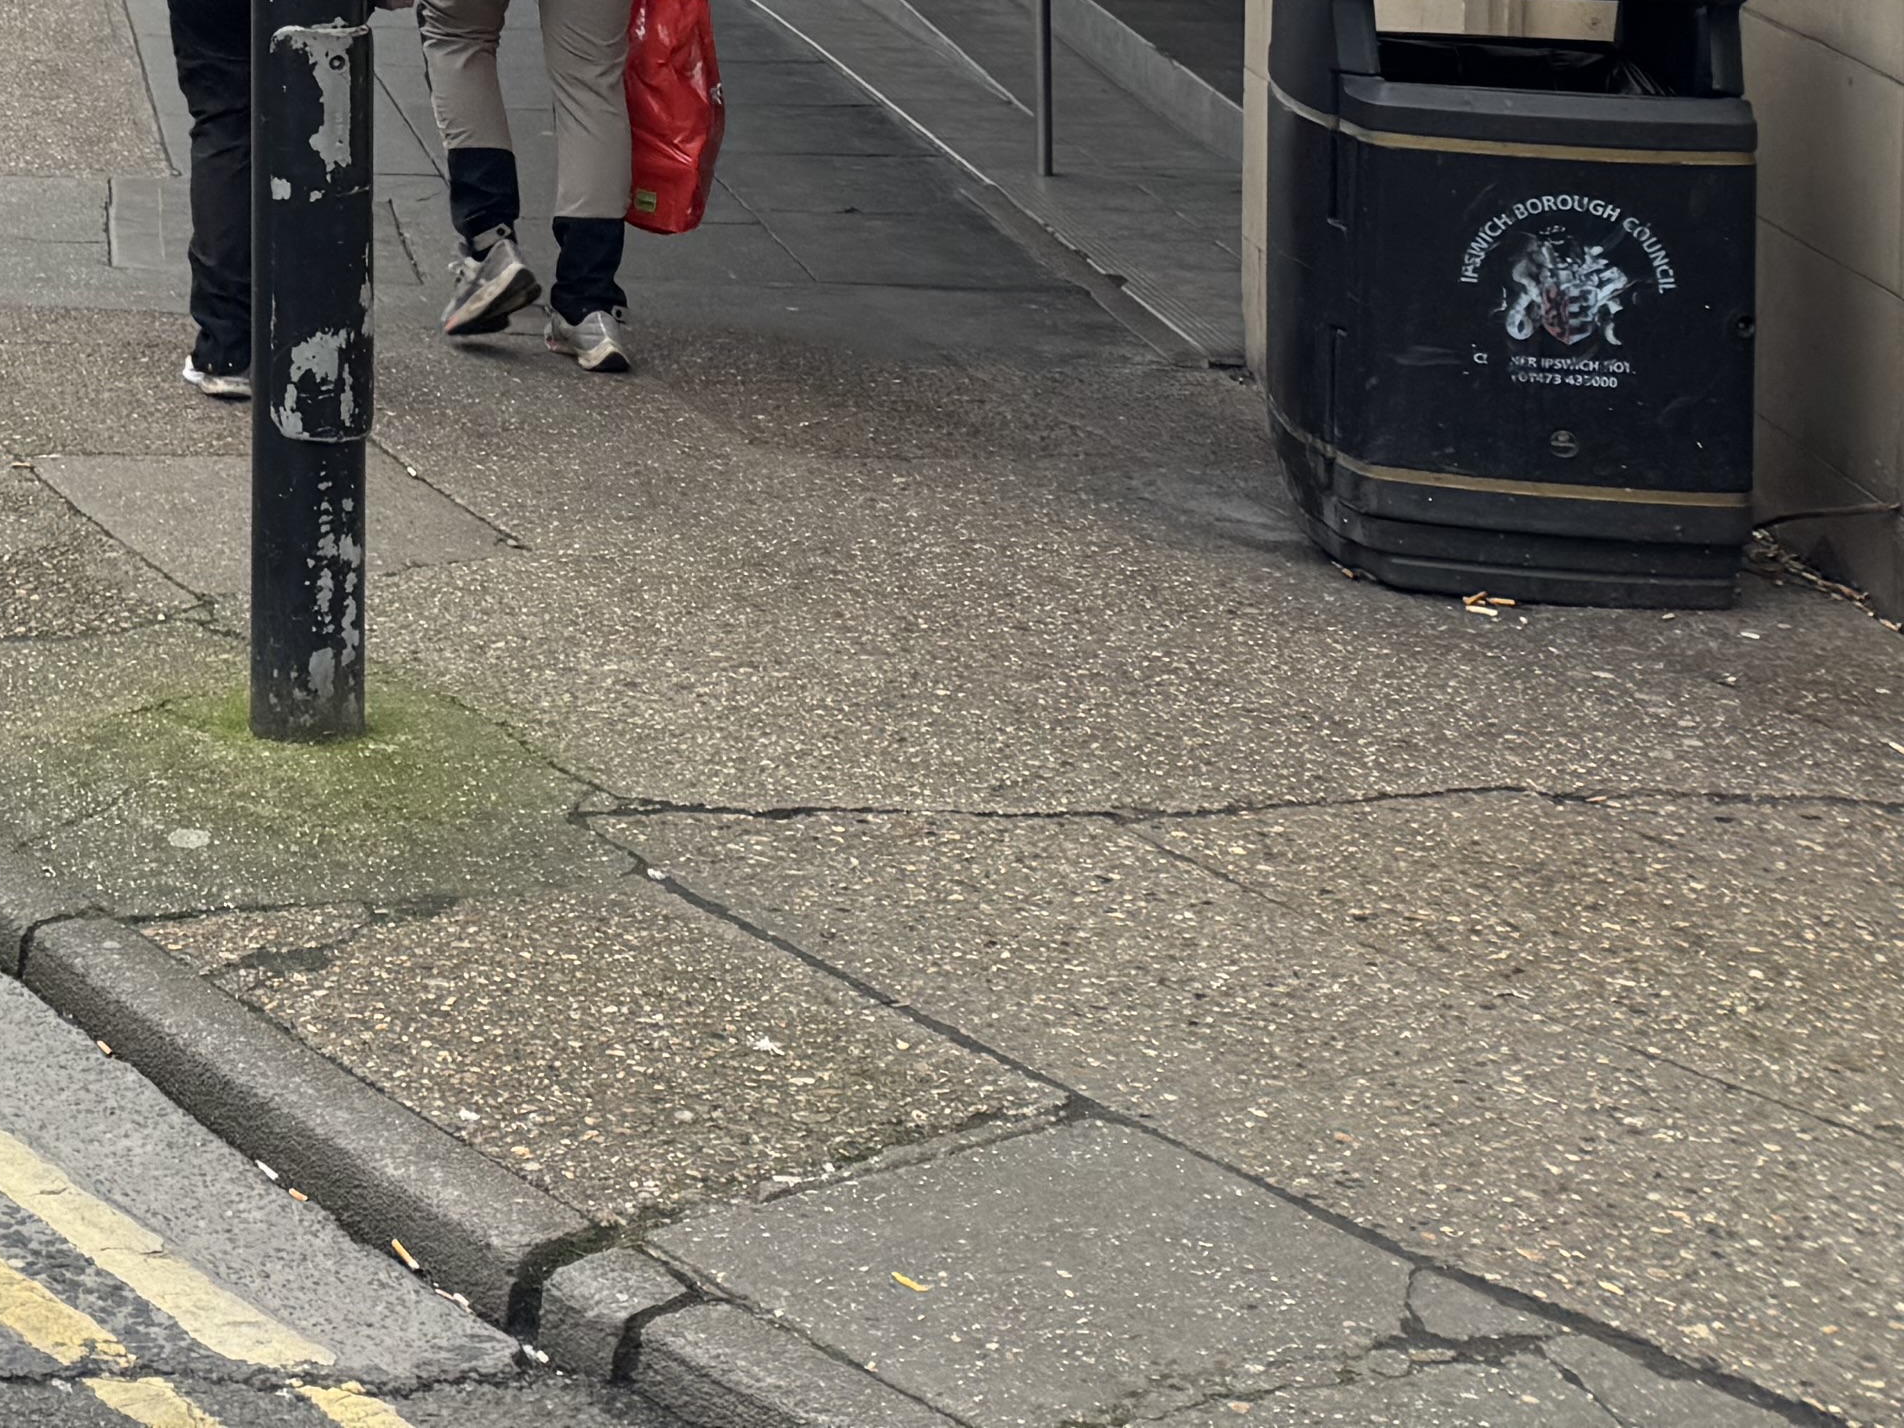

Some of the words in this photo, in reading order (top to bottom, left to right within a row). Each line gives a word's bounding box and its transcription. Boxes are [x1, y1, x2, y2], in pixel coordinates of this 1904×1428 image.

[1460, 213, 1513, 283] IPSWICH
[1513, 194, 1622, 222] BOROUGH
[1622, 216, 1678, 294] COUNCIL
